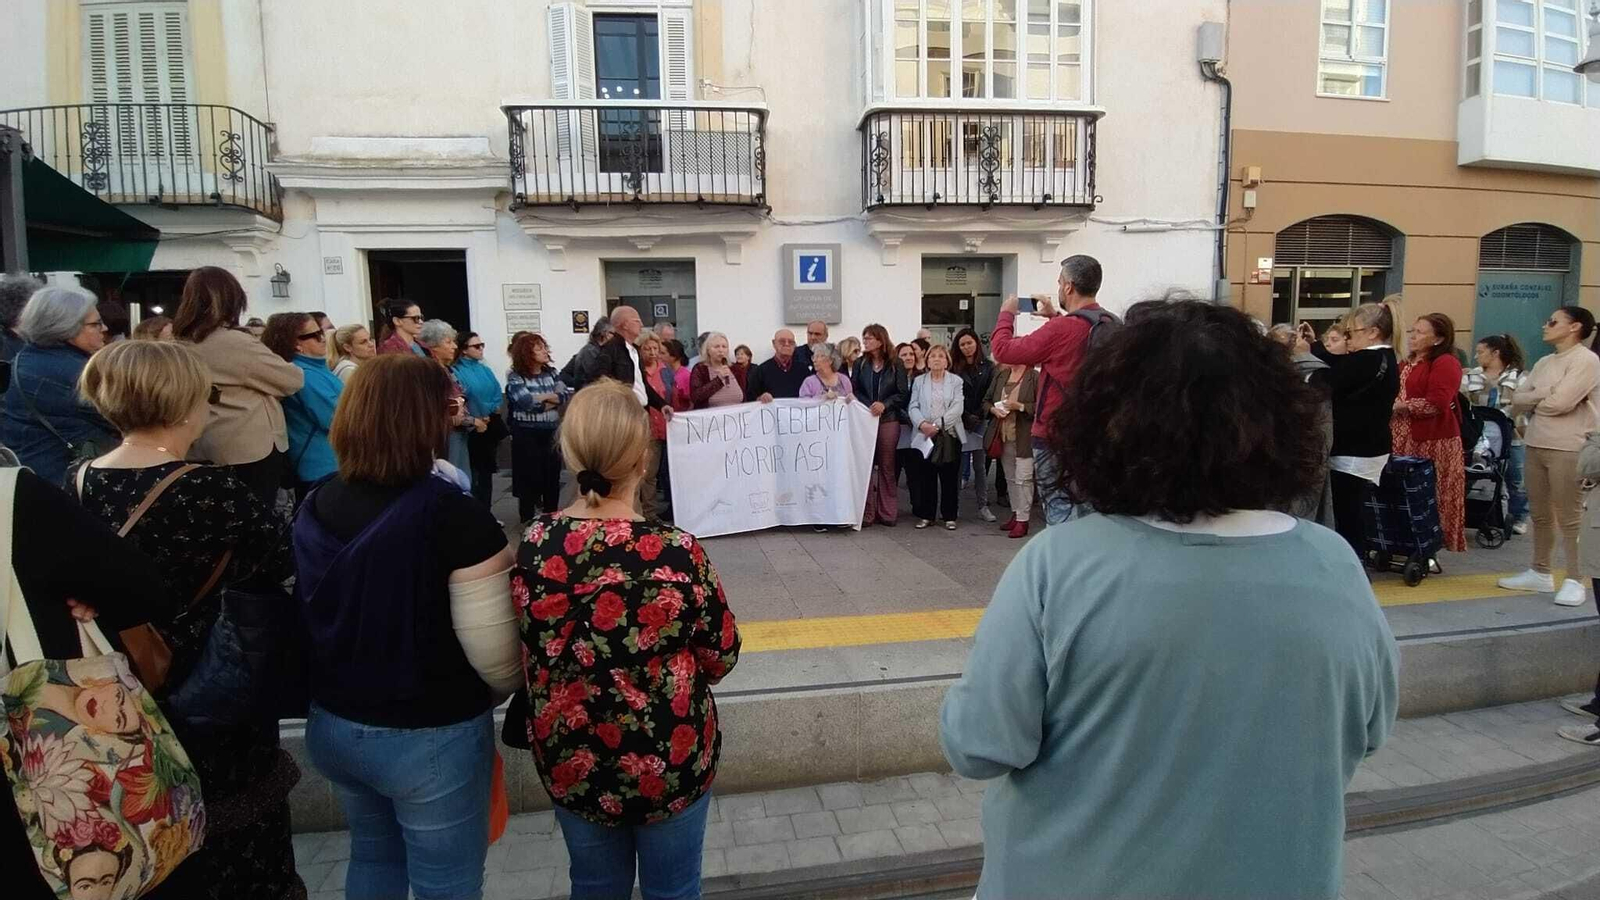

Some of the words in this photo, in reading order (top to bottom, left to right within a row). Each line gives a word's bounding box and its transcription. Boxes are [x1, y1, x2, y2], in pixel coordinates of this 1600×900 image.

[686, 410, 752, 444] NADIE
[760, 402, 848, 436] DEBERÍA
[724, 444, 786, 479] MORIR
[794, 436, 829, 473] ASÍ
